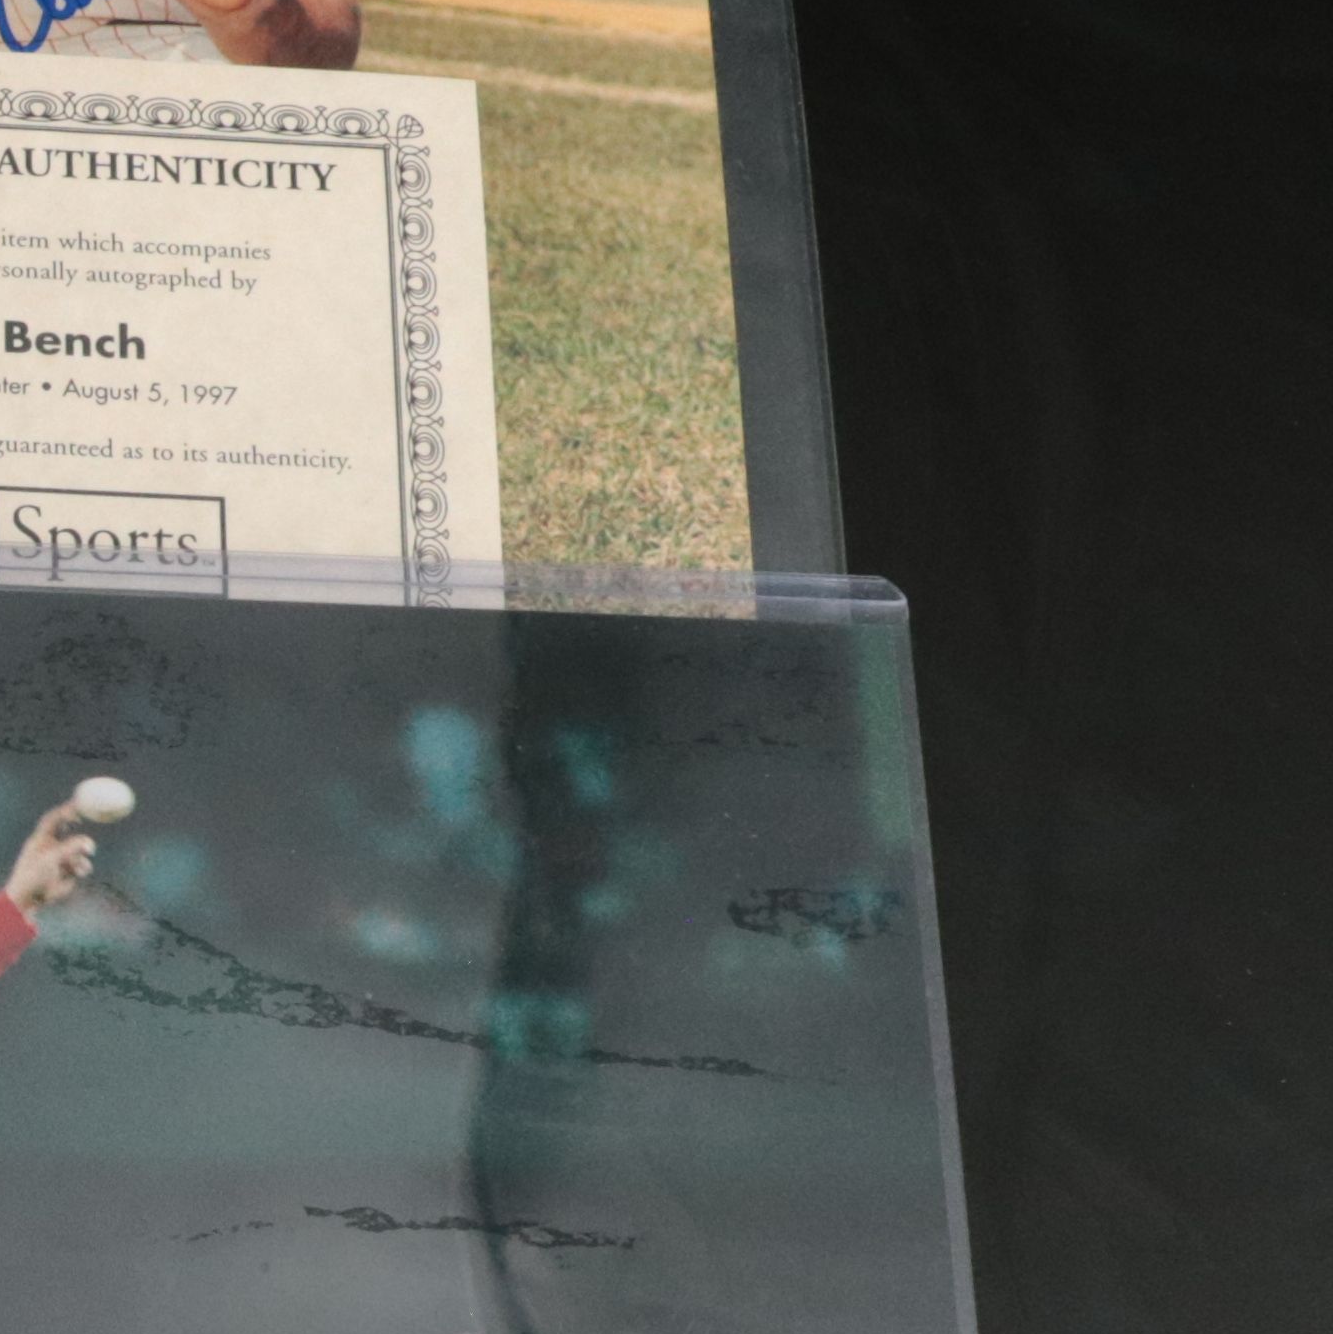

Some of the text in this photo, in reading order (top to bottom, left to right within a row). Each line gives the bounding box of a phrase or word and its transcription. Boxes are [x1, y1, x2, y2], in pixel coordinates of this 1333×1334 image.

[1, 228, 49, 249] item
[58, 230, 124, 253] which
[132, 239, 271, 264] accompanies
[86, 267, 222, 293] autographed
[230, 269, 257, 296] by
[3, 319, 146, 361] Bench
[62, 378, 139, 406] August
[148, 382, 169, 407] 5,
[180, 383, 238, 406] 1997
[122, 446, 144, 460] as
[152, 445, 174, 461] to
[183, 442, 208, 463] its
[216, 444, 352, 475] authenticity.
[11, 504, 201, 582] Sports
